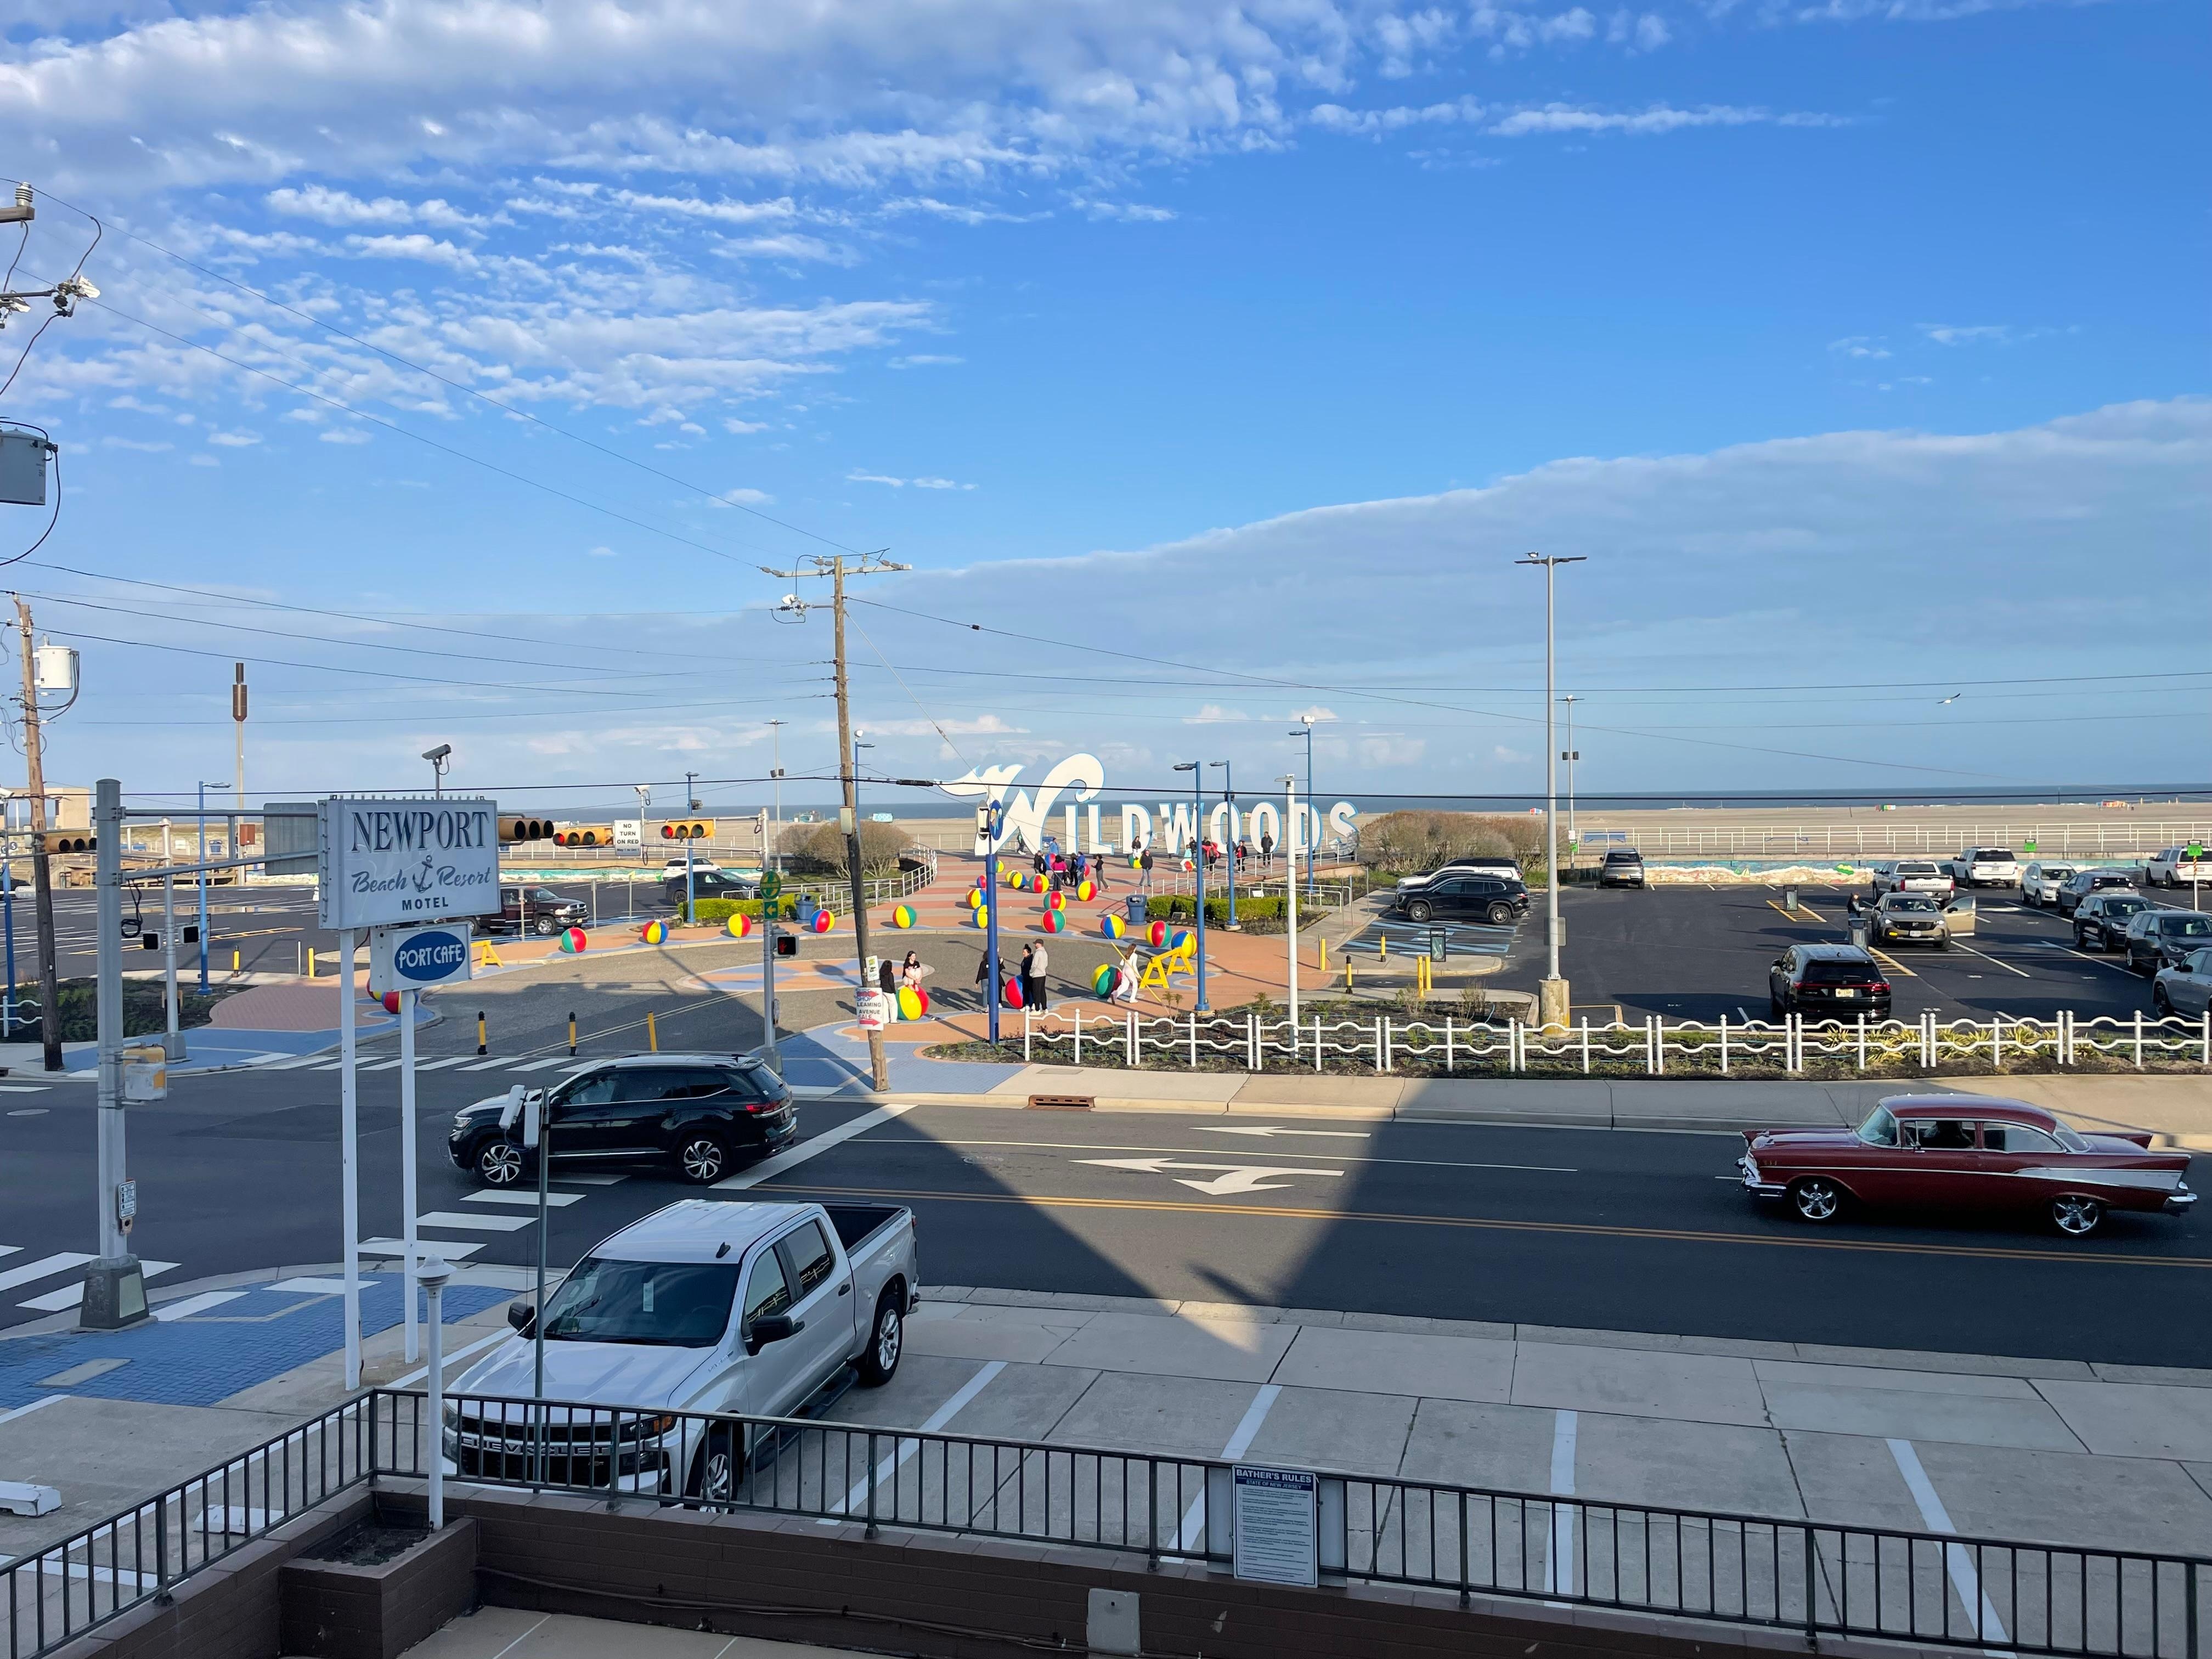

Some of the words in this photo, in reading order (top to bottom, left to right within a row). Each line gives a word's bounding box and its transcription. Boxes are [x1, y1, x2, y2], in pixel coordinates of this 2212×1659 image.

[351, 811, 489, 853] NEWPORT
[351, 869, 407, 893] Beach
[436, 866, 492, 887] Resort
[402, 896, 449, 911] MOTEL
[398, 947, 433, 969] PORT
[433, 944, 463, 964] CAFE
[1237, 1469, 1280, 1480] BATHER'S
[1282, 1474, 1311, 1483] RULES
